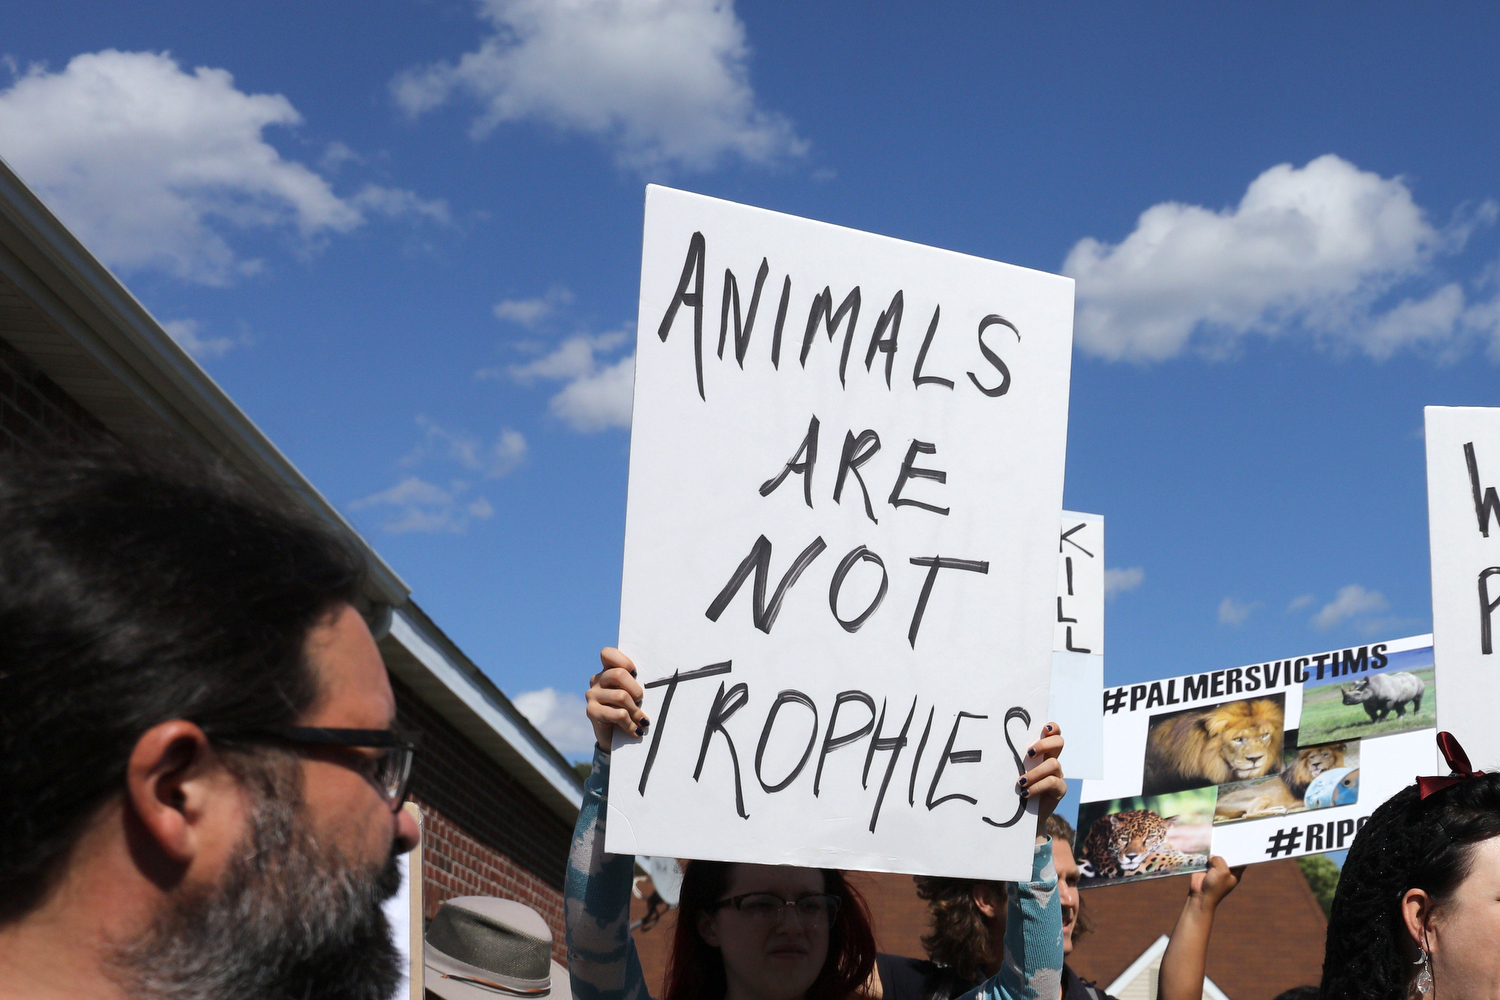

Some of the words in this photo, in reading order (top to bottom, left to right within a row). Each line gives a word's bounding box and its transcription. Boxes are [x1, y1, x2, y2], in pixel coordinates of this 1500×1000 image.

[657, 230, 1022, 402] ANIMALS
[759, 413, 950, 524] ARE
[705, 534, 989, 650] NOT
[1057, 522, 1094, 654] KILL
[1103, 643, 1388, 717] #PALMERSVICTIMS
[638, 659, 1032, 834] TROPHIES
